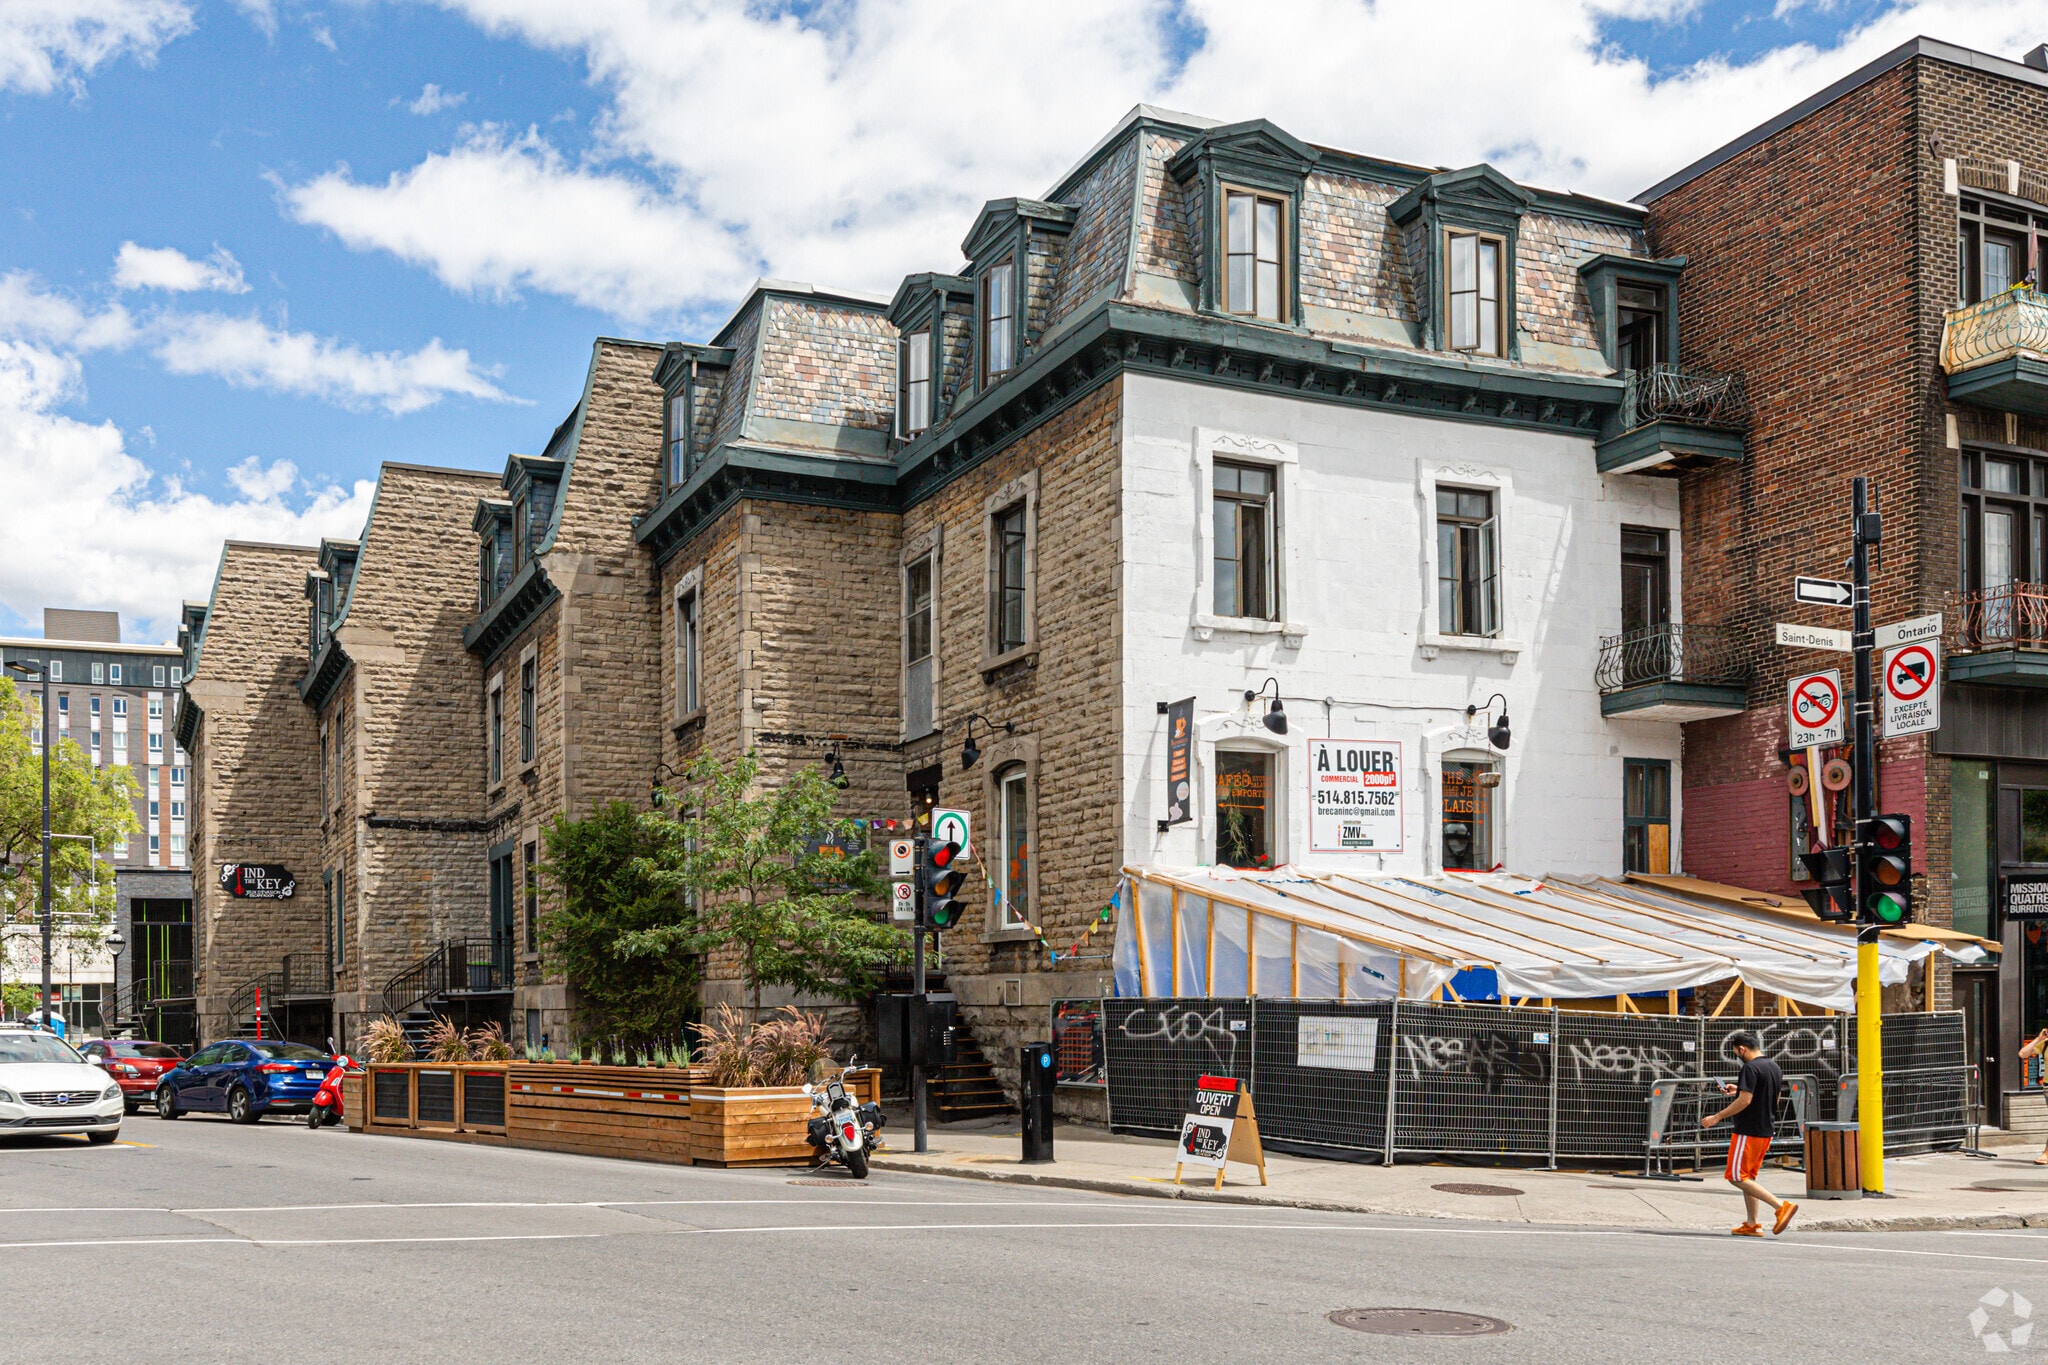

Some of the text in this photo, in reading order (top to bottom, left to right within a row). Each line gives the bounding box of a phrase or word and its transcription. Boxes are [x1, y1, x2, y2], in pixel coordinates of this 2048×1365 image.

[1898, 623, 1937, 640] Ontario
[1782, 631, 1834, 647] Saint-Denis
[1890, 708, 1932, 723] LIVRAISON
[1896, 717, 1926, 730] LOCALE
[1797, 733, 1815, 745] 23h
[1824, 728, 1837, 740] 7h
[1317, 744, 1394, 772] À LOUER
[1320, 775, 1359, 783] COMMERCIAL
[1317, 790, 1395, 806] 514.815.7562
[1317, 807, 1395, 817] brecaninc@gmail.com
[1342, 826, 1361, 839] ZMV
[257, 878, 282, 890] KEY
[2009, 882, 2048, 894] MISSION
[2009, 893, 2048, 905] QUATRE
[2009, 904, 2048, 914] BURRITOS
[1195, 1091, 1234, 1107] OUVERT
[1200, 1104, 1221, 1116] OPEN
[1202, 1138, 1219, 1150] KEY
